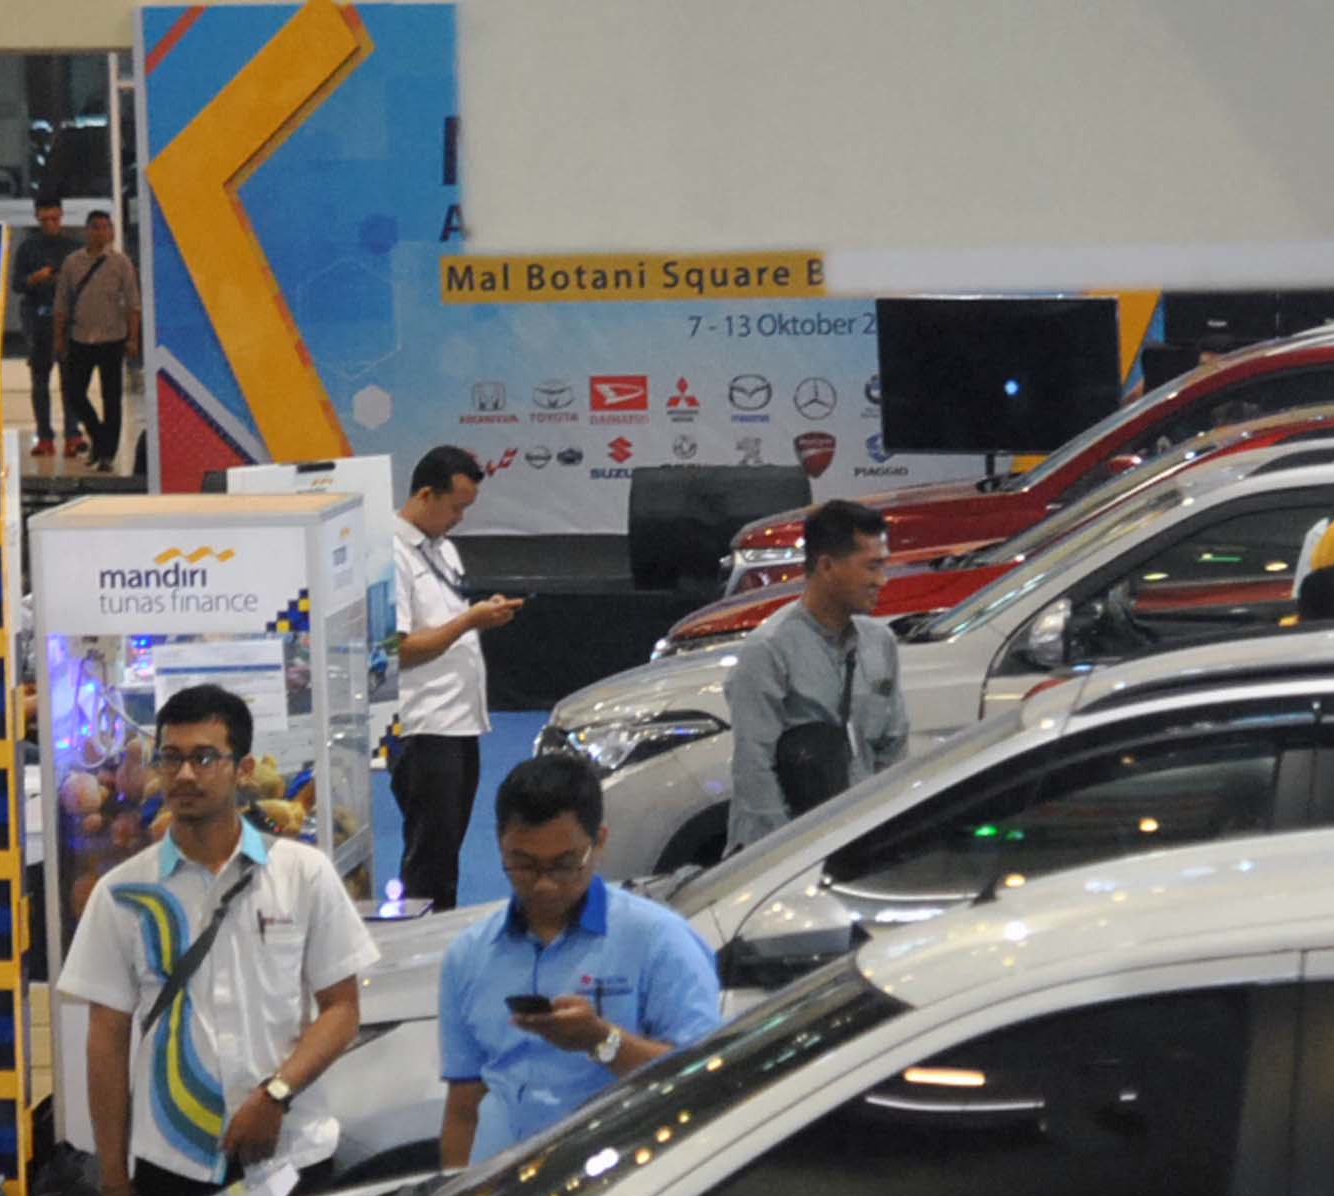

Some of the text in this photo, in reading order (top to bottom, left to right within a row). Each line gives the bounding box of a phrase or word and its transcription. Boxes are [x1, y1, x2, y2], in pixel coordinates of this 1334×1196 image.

[446, 262, 510, 292] Mal
[527, 262, 646, 291] Botani
[662, 262, 791, 294] Square
[688, 316, 703, 337] 7
[725, 314, 752, 337] 13
[757, 313, 857, 336] Oktober
[530, 412, 579, 425] TOYOTA
[590, 468, 634, 479] SUZU
[854, 466, 909, 477] PIAGGIO
[99, 561, 207, 589] mandiri
[99, 588, 259, 614] tunas finance
